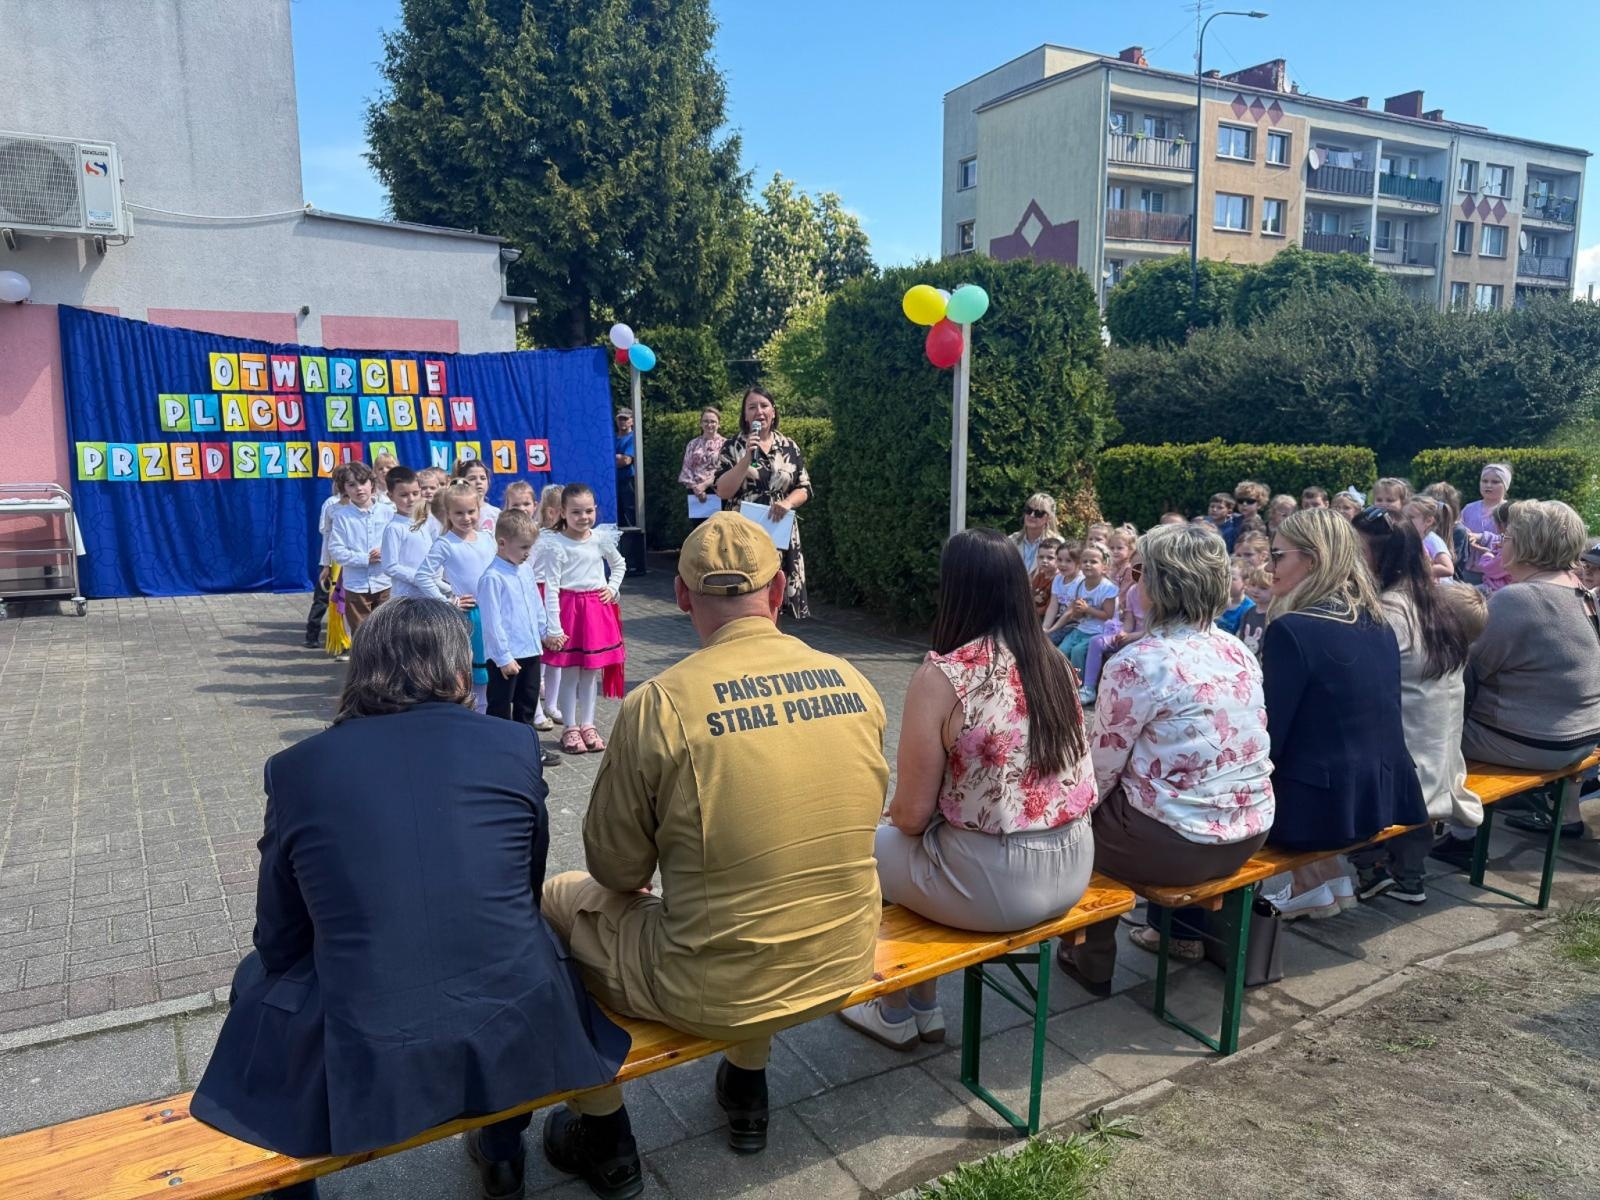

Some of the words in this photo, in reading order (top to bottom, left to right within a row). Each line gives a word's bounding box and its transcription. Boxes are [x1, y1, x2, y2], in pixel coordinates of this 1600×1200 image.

[214, 356, 442, 393] OTWARCIE
[164, 399, 303, 428] PLACU
[330, 400, 475, 427] ZABAW
[83, 445, 389, 477] PRZEDSZKO
[712, 668, 846, 704] PAŃSTWOWA
[706, 703, 779, 737] STRAŻ
[782, 692, 868, 724] POŻARNA
